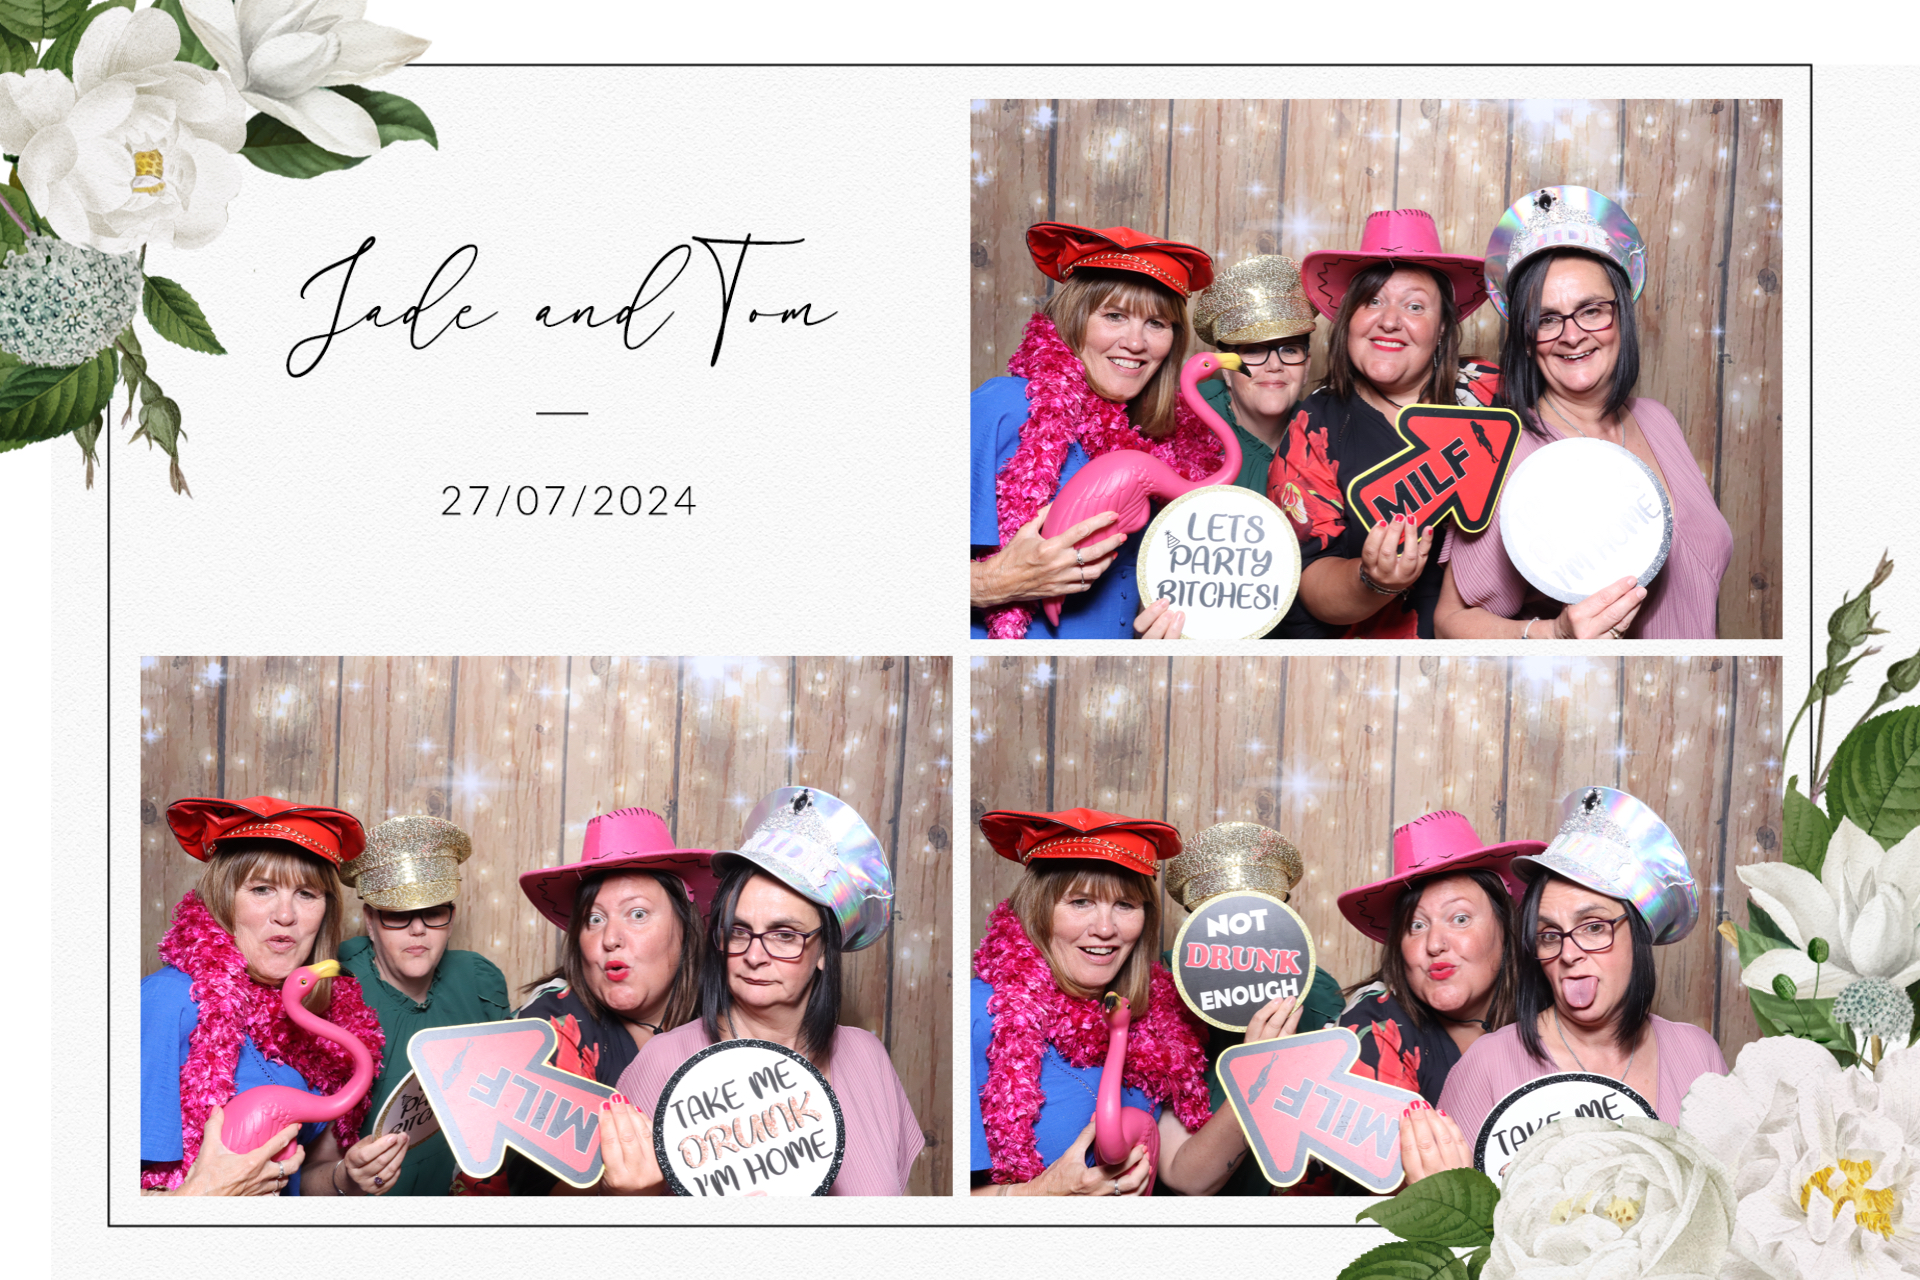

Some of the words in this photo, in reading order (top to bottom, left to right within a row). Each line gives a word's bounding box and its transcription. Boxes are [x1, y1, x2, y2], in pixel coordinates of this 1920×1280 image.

[1371, 437, 1470, 523] MILF
[1187, 512, 1265, 544] LETS
[1169, 544, 1273, 577] PARTY
[1156, 579, 1279, 610] BITCHES!
[1206, 908, 1268, 938] NOT
[1184, 942, 1302, 975] DRUNK
[1200, 978, 1299, 1011] ENOUGH
[670, 1079, 745, 1129] TAKE
[748, 1058, 797, 1099] ME
[1574, 1092, 1624, 1121] ME
[467, 1066, 600, 1155] MILF
[1272, 1077, 1400, 1161] MILF
[677, 1090, 823, 1169] DRUNK
[693, 1165, 741, 1196] I'M
[743, 1129, 833, 1185] HOME
